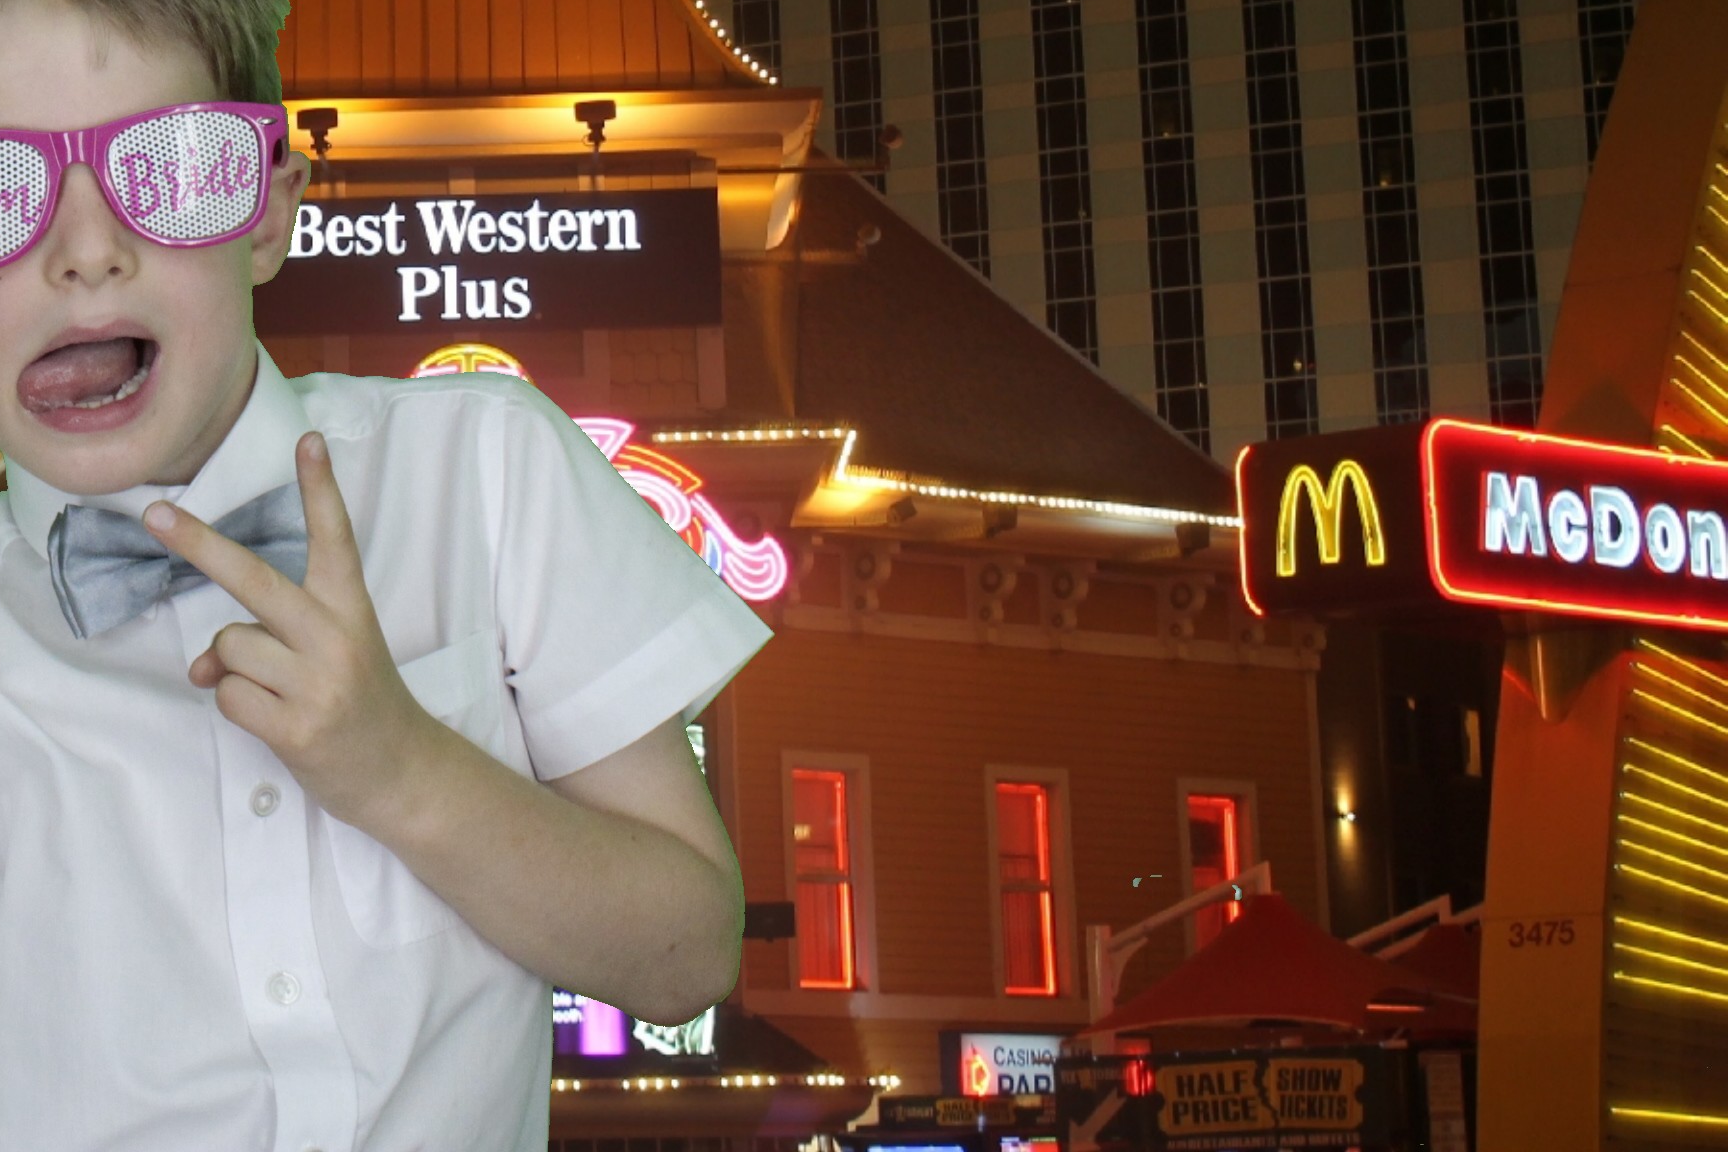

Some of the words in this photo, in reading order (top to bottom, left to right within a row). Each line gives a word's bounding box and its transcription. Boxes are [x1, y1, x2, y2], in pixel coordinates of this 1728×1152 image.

[119, 140, 259, 219] Bride
[286, 201, 406, 259] Best
[416, 198, 642, 255] Western
[397, 264, 532, 321] Plus
[1483, 471, 1728, 580] McDon
[1508, 920, 1575, 948] 3475
[993, 1046, 1056, 1067] CASINO
[1175, 1069, 1249, 1098] HALF
[1276, 1068, 1343, 1093] SHOW
[1173, 1097, 1259, 1126] PRICE
[1279, 1094, 1349, 1120] TICKETS
